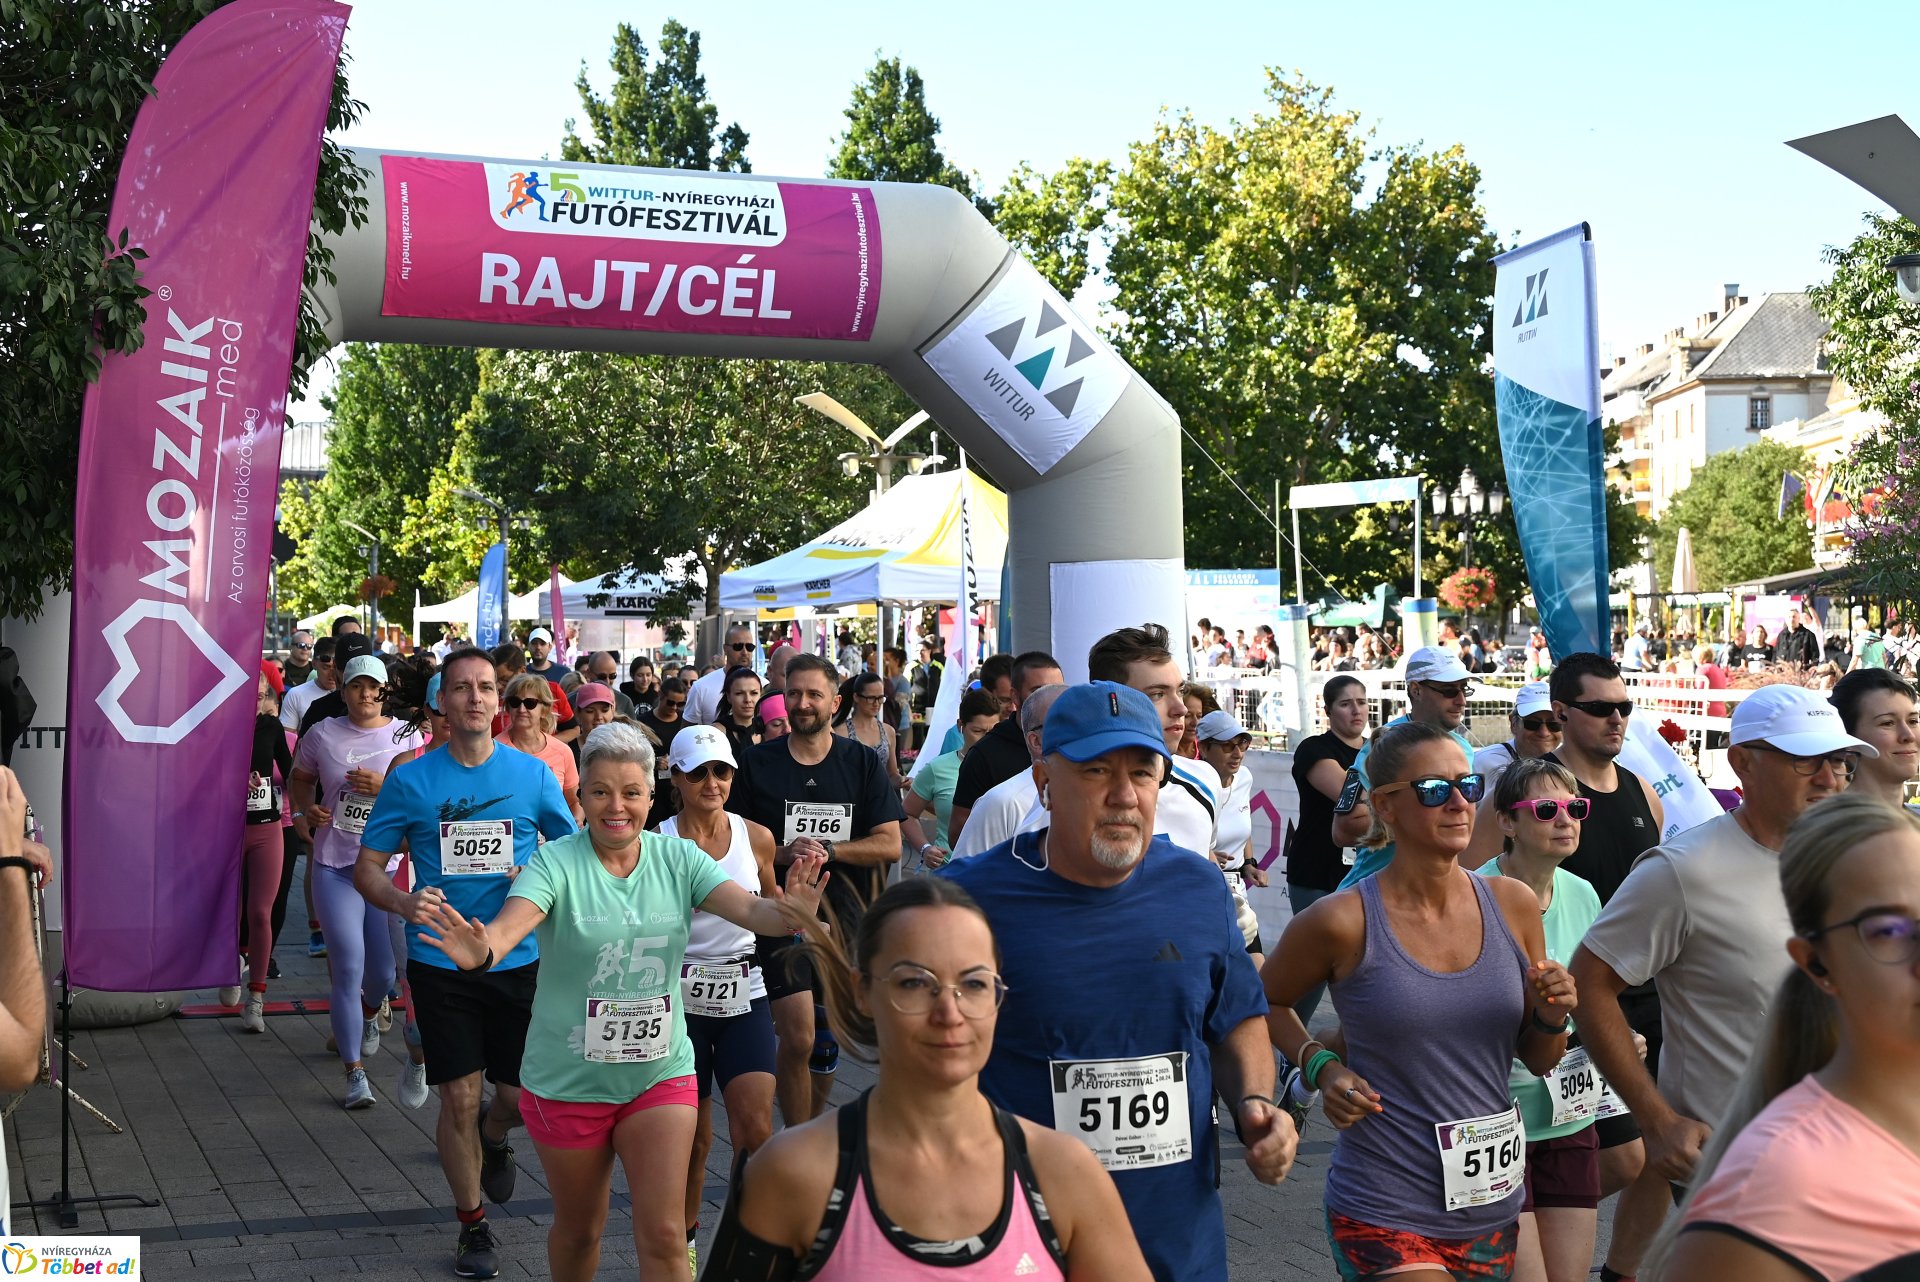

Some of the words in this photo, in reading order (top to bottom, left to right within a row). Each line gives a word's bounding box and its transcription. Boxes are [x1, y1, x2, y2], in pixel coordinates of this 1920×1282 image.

[588, 186, 775, 209] WITTUR-NYÍREGYHÁZI
[400, 181, 413, 280] www.mozaikmed.hu
[551, 201, 778, 236] FUTÓFESZTIVÁL
[851, 192, 869, 333] www.nyiregyhazifutofesztival.hu
[479, 252, 792, 320] RAJT/CÉL
[215, 318, 242, 398] med
[983, 367, 1036, 422] WITTUR
[139, 306, 214, 599] MOZAIK
[233, 407, 260, 522] futóközösség
[231, 526, 248, 577] orvosi
[228, 582, 242, 604] Az
[344, 805, 371, 821] 506
[795, 818, 841, 833] 5166
[453, 838, 502, 856] 5052
[690, 981, 738, 1000] 5121
[601, 1017, 662, 1041] 5135
[1086, 1076, 1155, 1090] FUTÓFESZTIVÁL
[1560, 1069, 1593, 1099] 5094
[1079, 1091, 1169, 1132] 5169
[1468, 1125, 1515, 1144] FUTÓFESZTIVÁL
[1464, 1134, 1520, 1178] 5160
